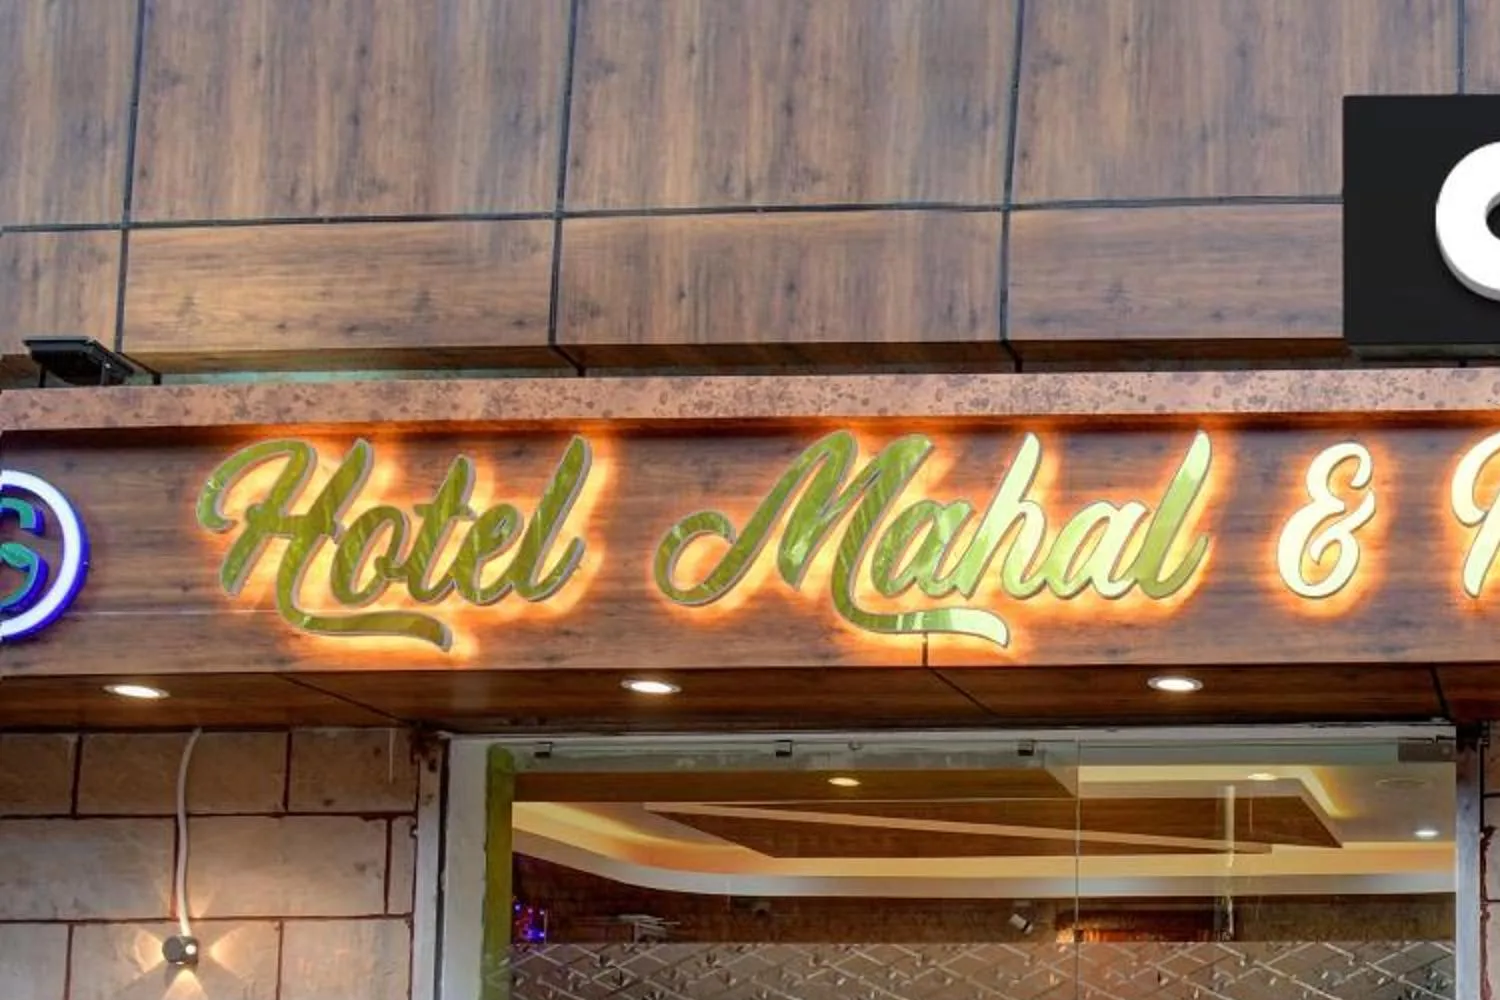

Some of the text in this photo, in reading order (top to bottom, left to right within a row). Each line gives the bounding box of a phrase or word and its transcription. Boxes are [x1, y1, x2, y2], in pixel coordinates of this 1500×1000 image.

[196, 434, 593, 652] Hotel
[653, 427, 1212, 649] Mahal
[1277, 441, 1377, 599] &
